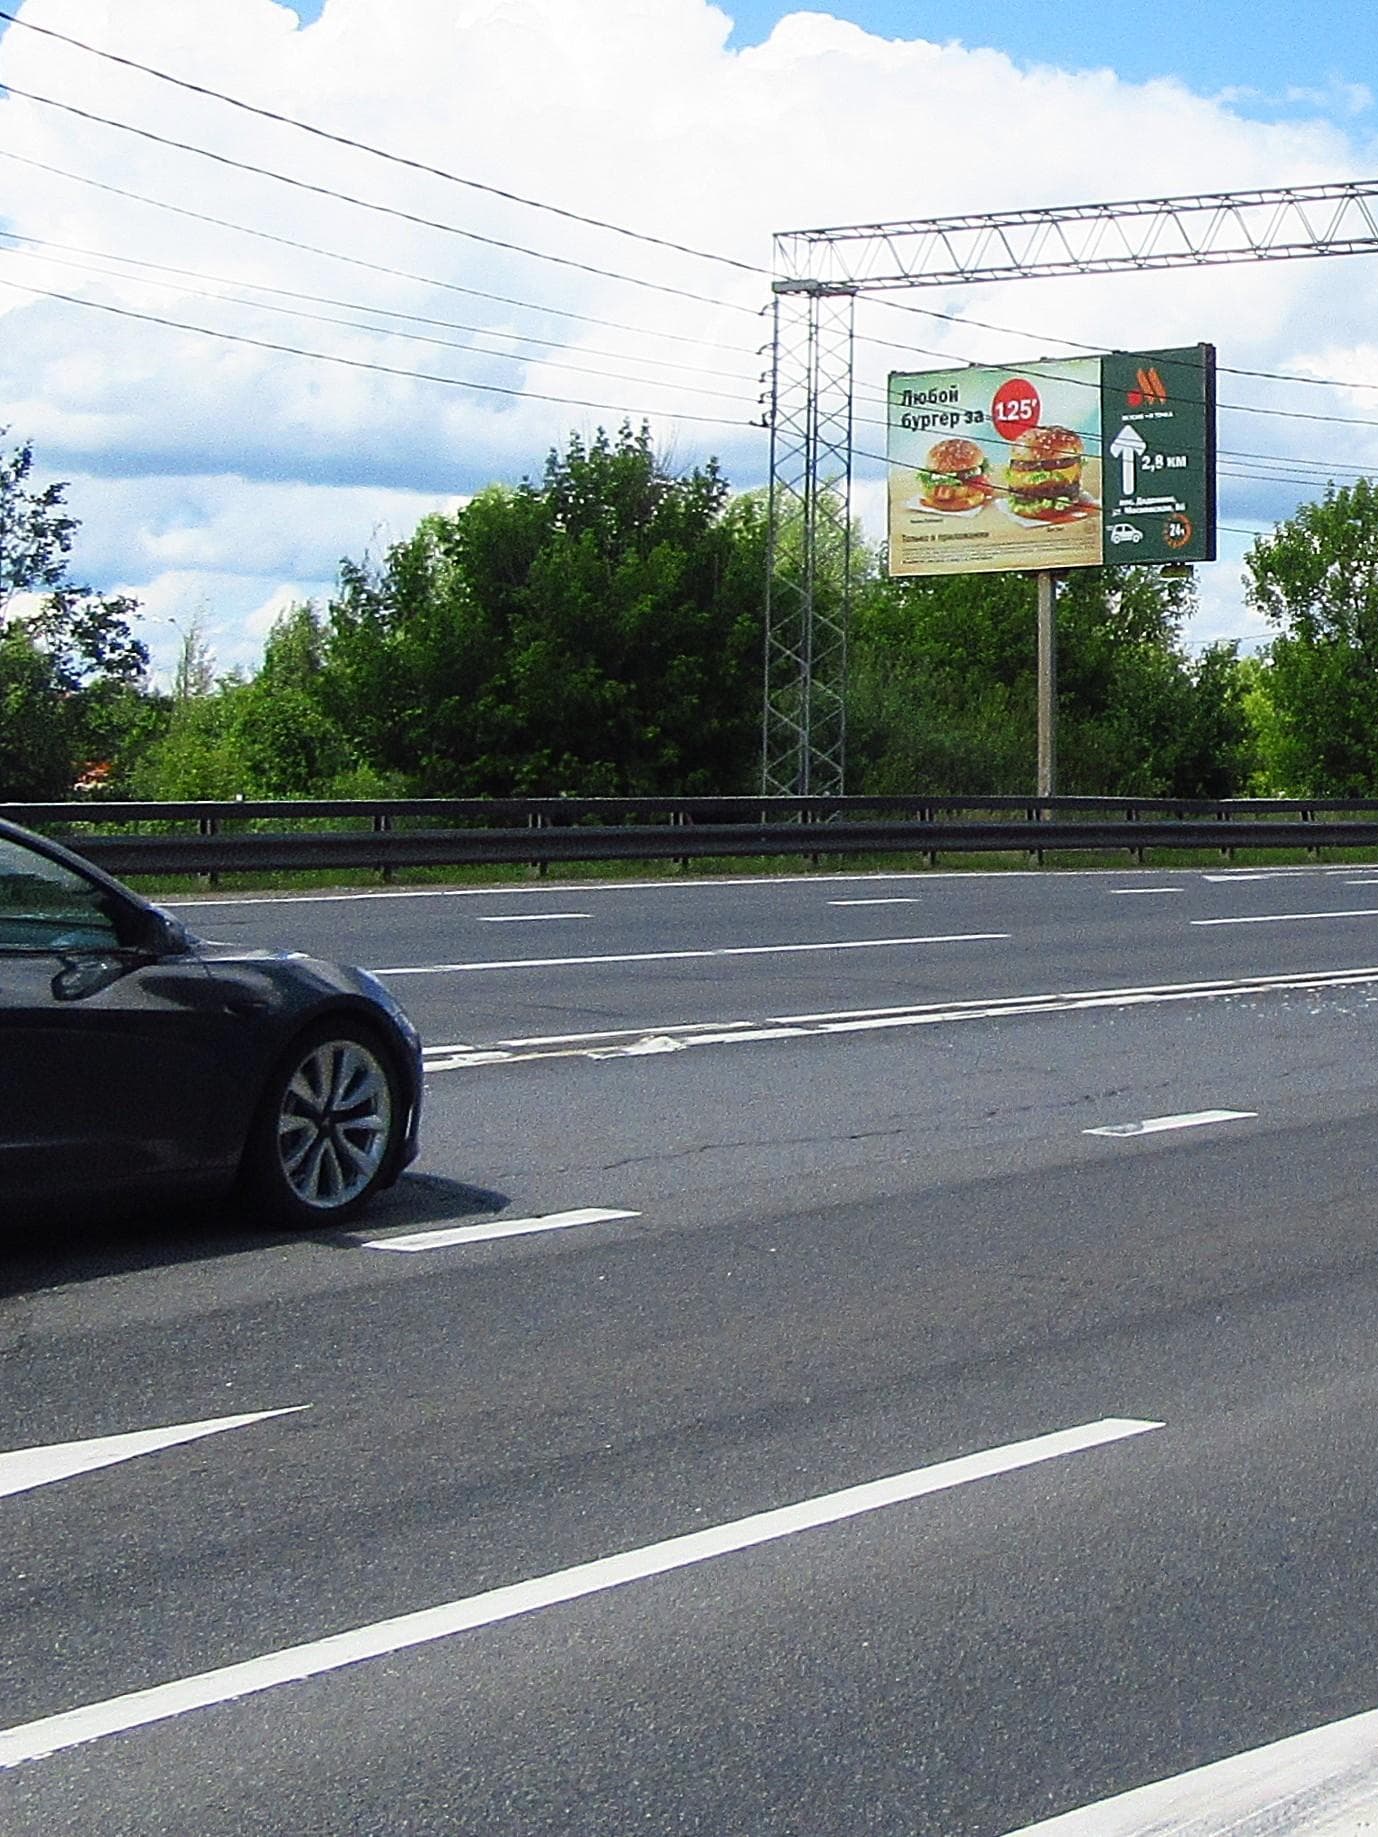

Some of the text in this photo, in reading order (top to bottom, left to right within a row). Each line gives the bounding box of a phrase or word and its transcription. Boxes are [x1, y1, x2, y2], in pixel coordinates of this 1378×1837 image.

[901, 384, 959, 406] Любой
[901, 410, 985, 432] бургер за
[1141, 455, 1164, 472] 2,8
